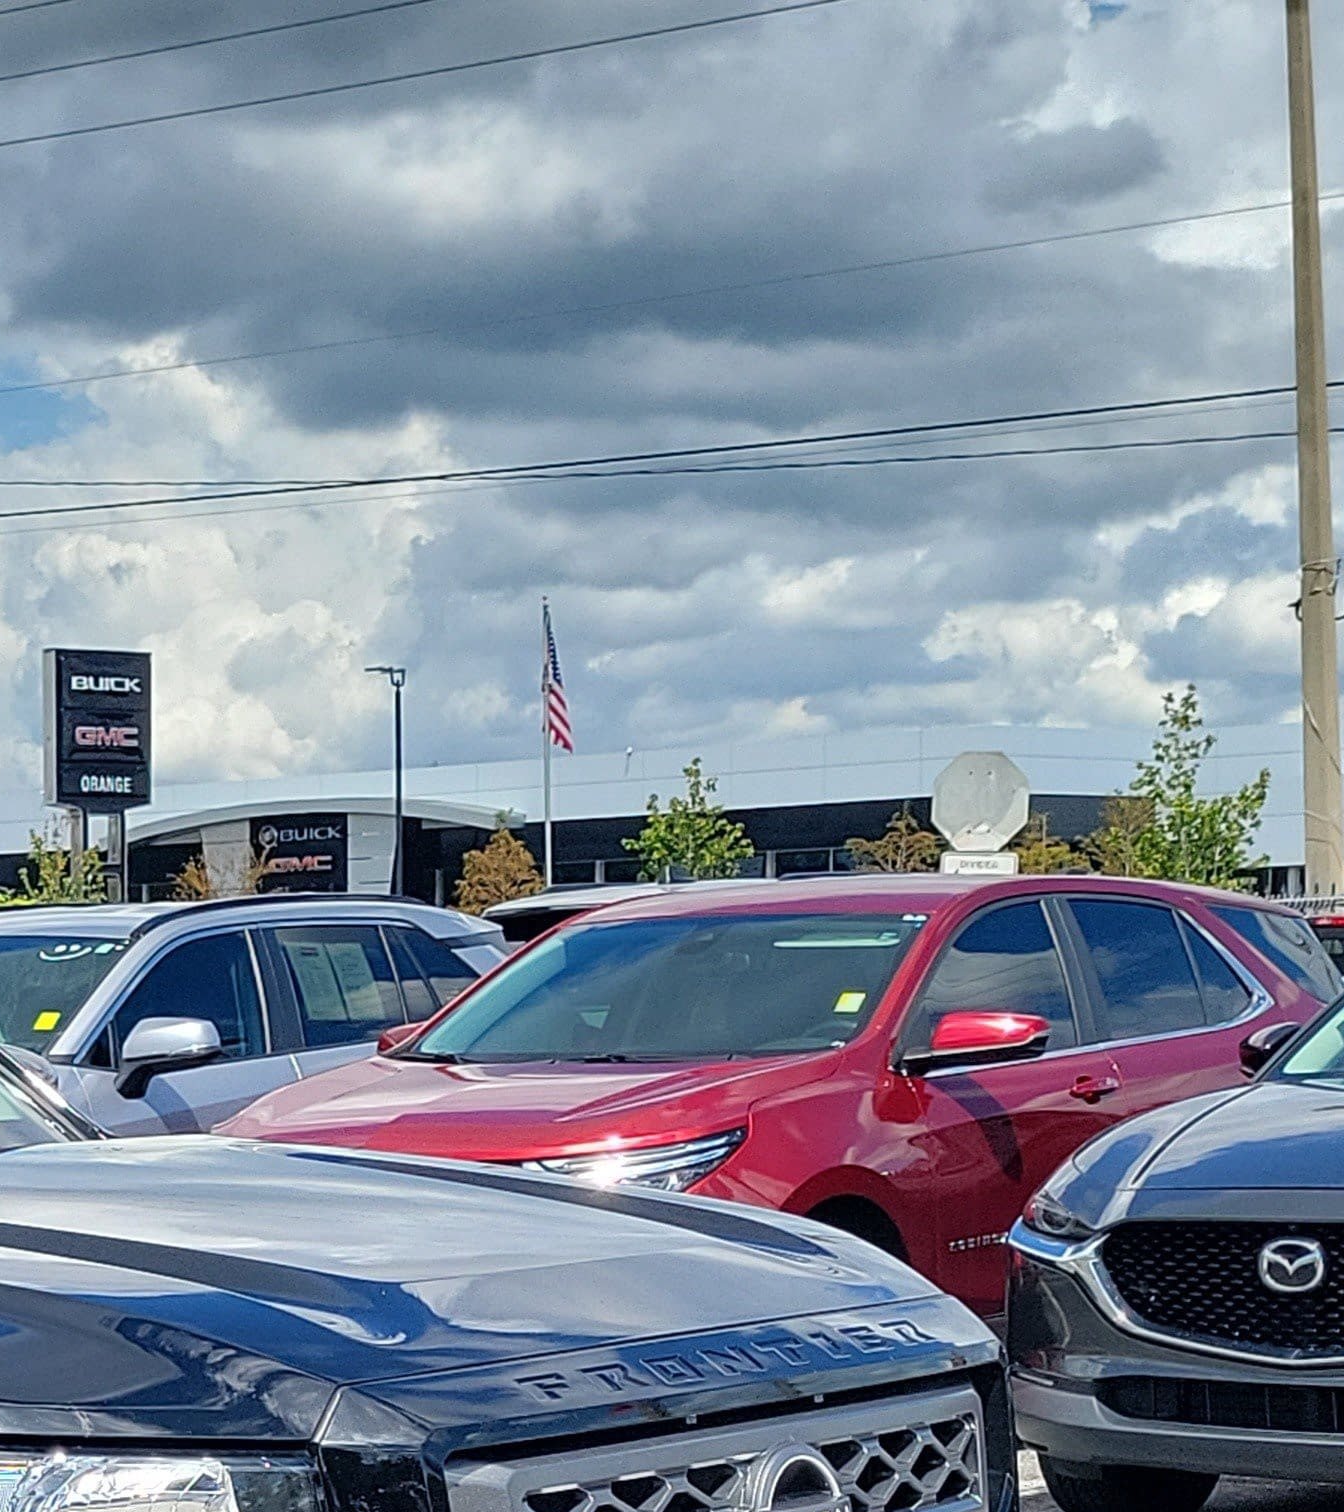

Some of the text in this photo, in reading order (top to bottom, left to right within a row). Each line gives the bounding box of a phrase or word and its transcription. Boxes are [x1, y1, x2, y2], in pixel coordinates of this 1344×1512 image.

[71, 675, 141, 692] BUICK
[75, 726, 139, 746] GMC
[80, 775, 132, 793] ORANGE
[280, 826, 343, 842] BUICK
[515, 1319, 936, 1401] FRONTIER
